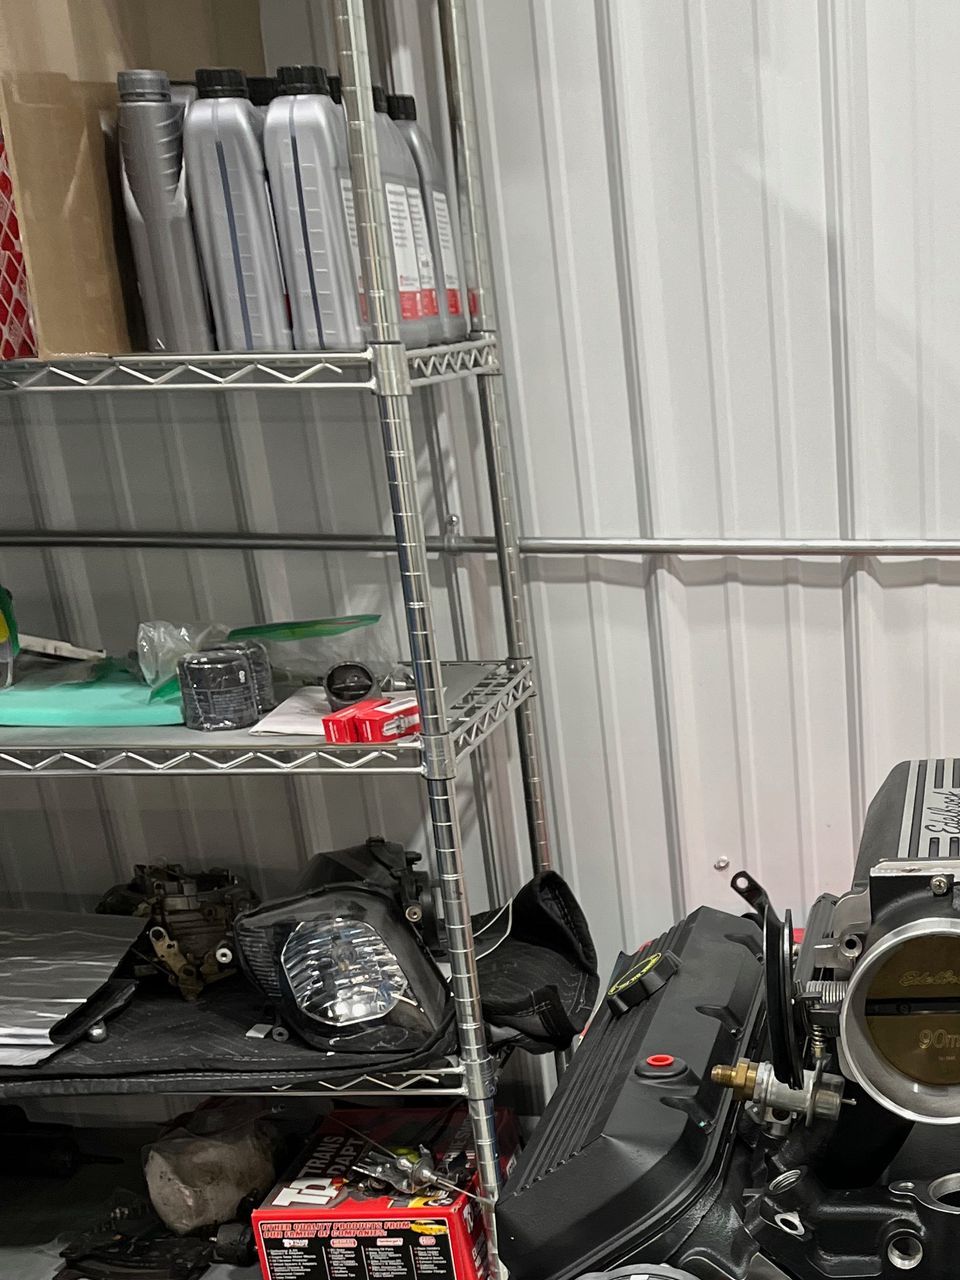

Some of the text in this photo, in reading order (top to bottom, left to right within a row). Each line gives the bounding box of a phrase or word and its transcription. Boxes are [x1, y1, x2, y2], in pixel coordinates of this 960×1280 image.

[302, 1135, 344, 1178] TRANS
[332, 1221, 383, 1230] PRODUCTS
[383, 1220, 411, 1229] FROM
